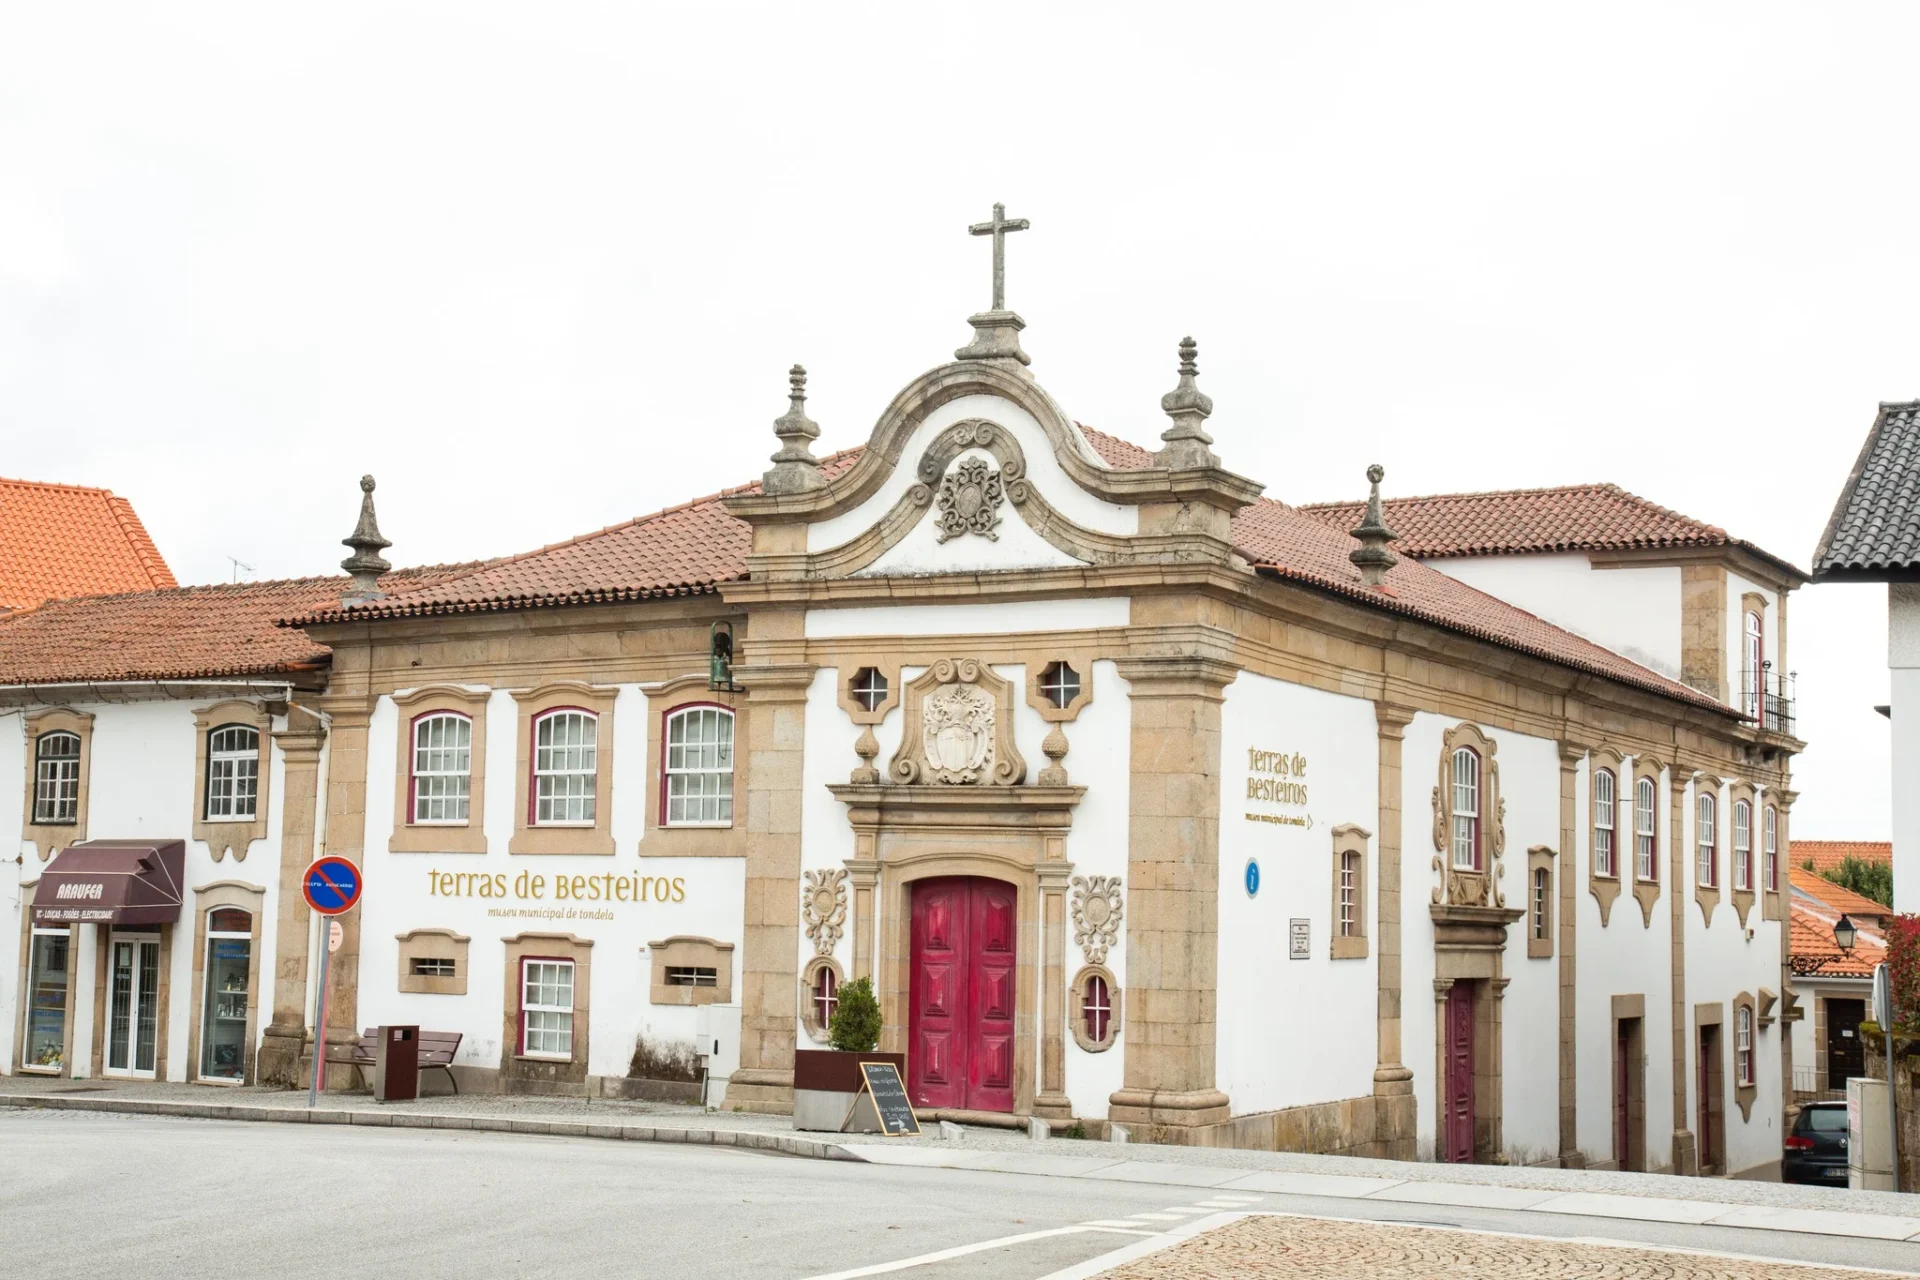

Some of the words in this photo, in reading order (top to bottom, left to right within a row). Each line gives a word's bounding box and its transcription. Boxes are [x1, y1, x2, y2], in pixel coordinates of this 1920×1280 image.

[1248, 745, 1289, 775] terras
[1291, 751, 1307, 778] de
[56, 883, 104, 900] ARAUFER
[428, 868, 507, 898] terras
[515, 869, 546, 900] de
[488, 908, 517, 918] museu
[518, 907, 565, 921] municipal
[566, 907, 577, 919] de
[579, 908, 614, 921] tondela
